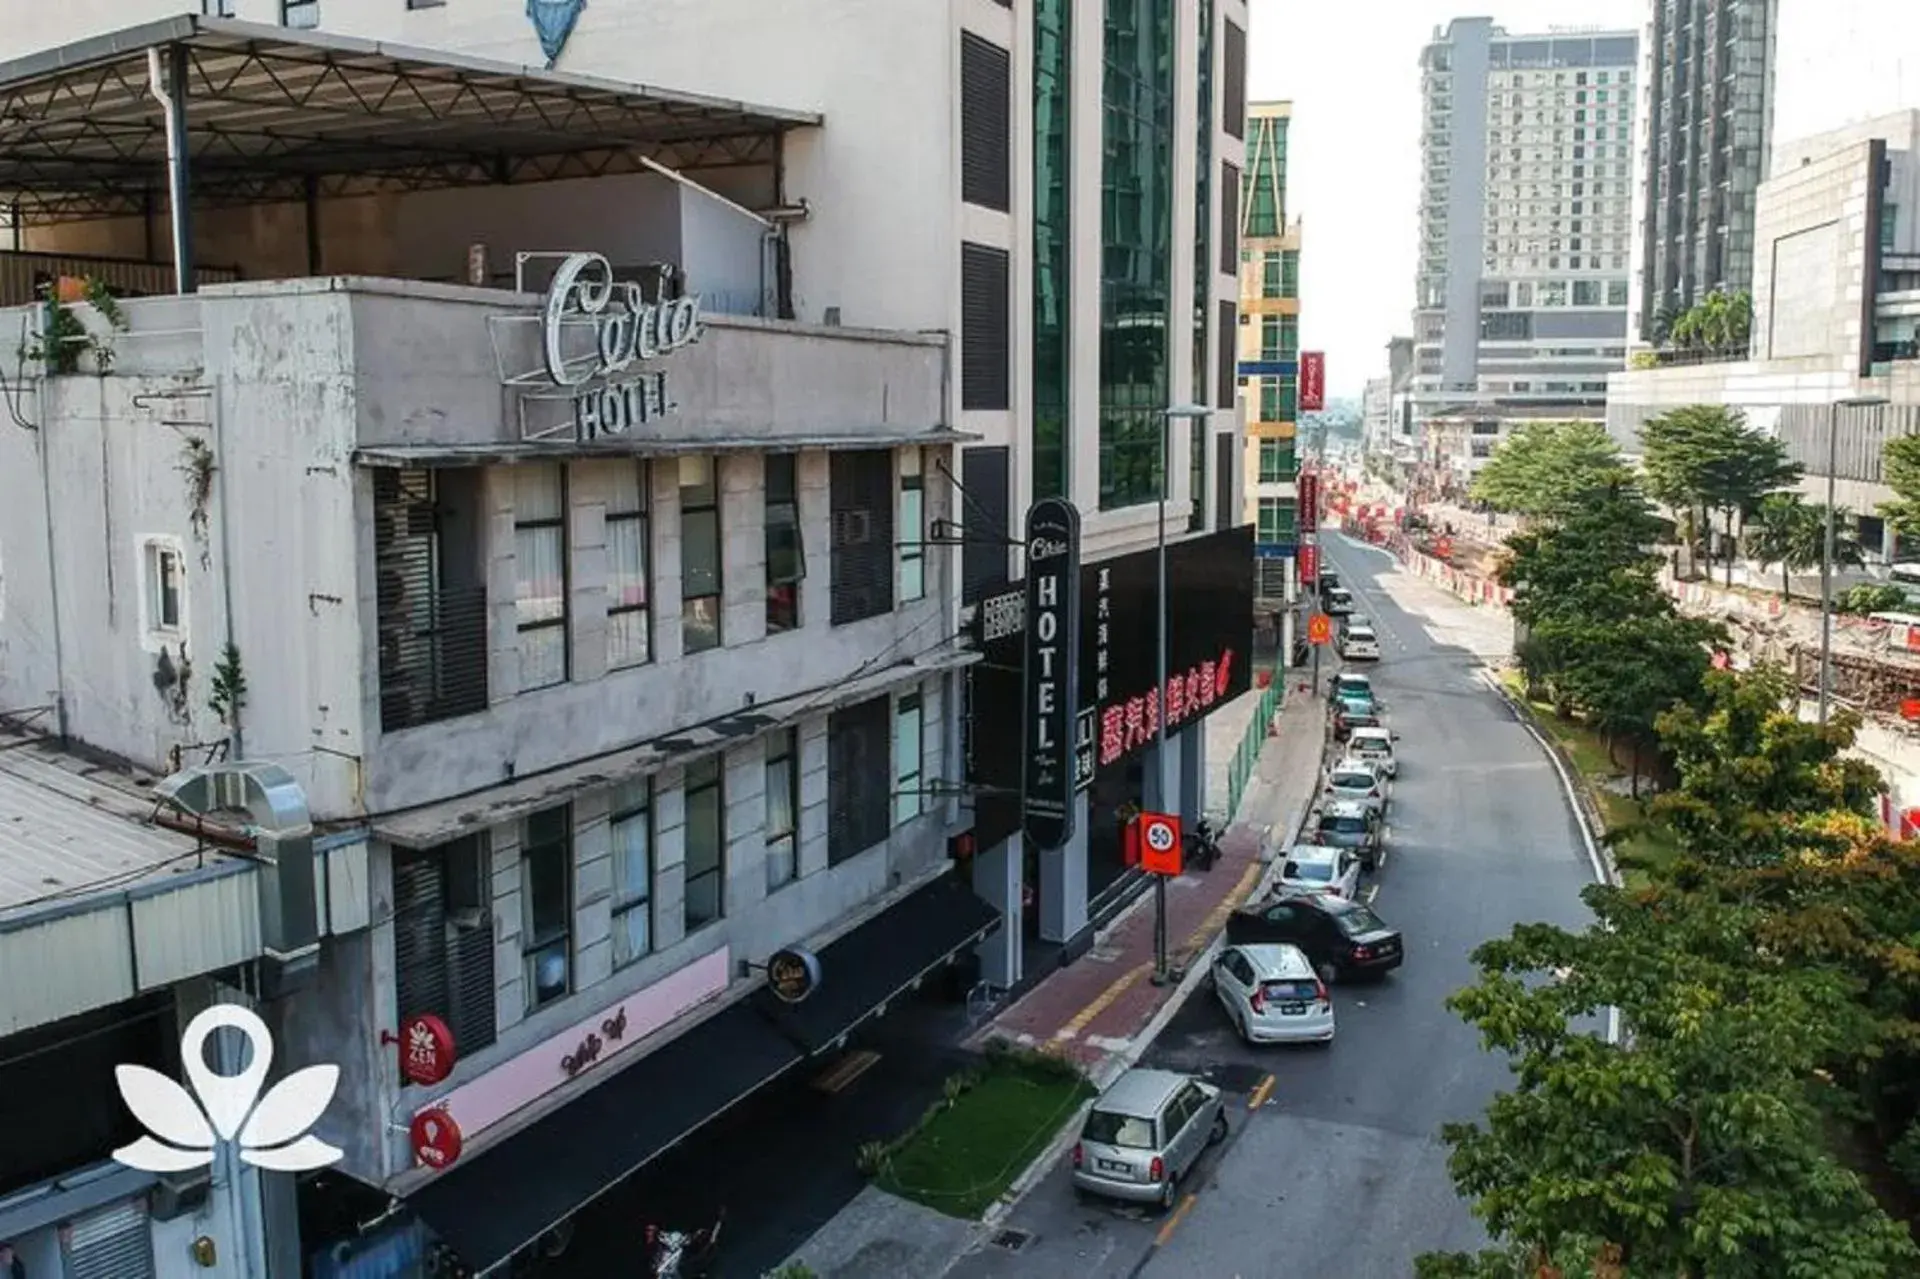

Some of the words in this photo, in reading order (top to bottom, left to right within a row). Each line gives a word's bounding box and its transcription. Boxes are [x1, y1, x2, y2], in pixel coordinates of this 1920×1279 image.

[573, 374, 679, 442] HOTEL
[1037, 574, 1058, 750] HOTEL
[1151, 826, 1169, 846] 50
[409, 1047, 436, 1065] ZEN
